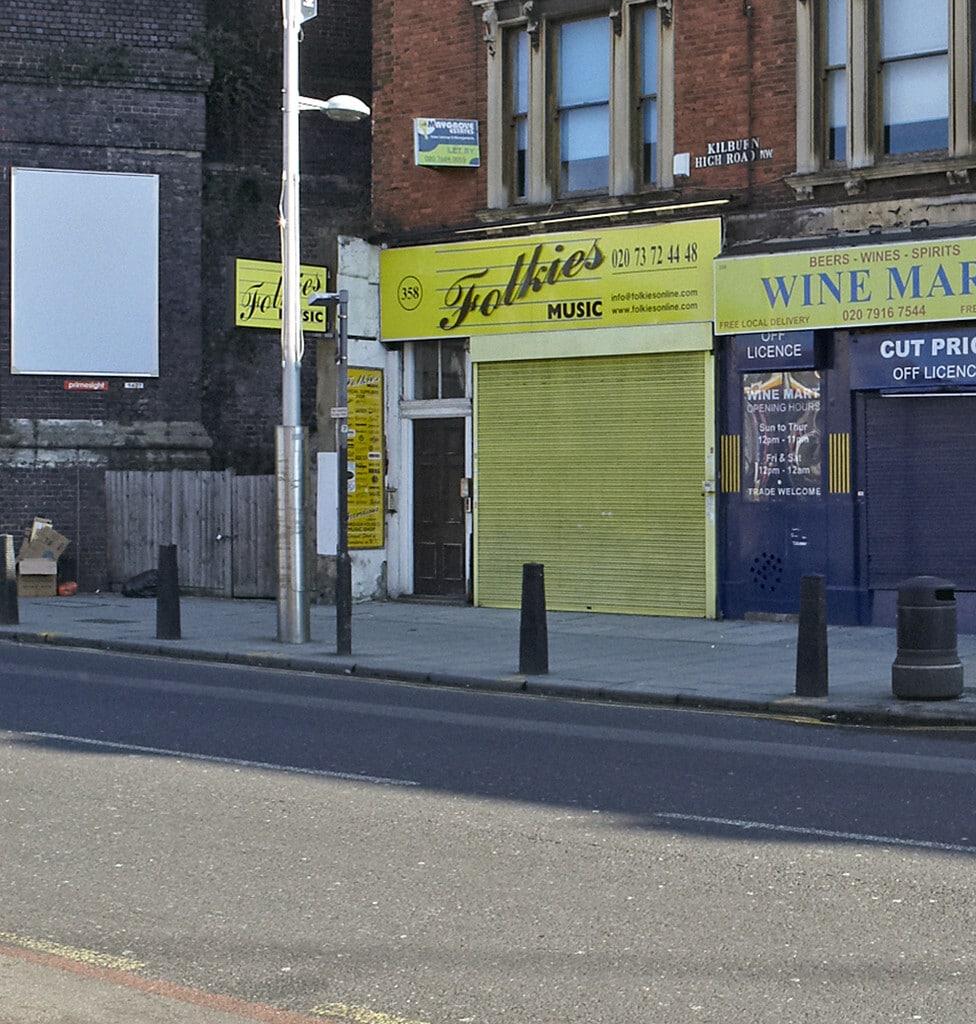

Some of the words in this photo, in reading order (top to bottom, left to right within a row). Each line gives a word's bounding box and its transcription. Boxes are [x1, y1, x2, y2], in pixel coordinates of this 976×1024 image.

[612, 248, 630, 268] 020
[634, 246, 646, 266] 73
[651, 245, 663, 265] 72
[667, 244, 680, 263] 44
[684, 242, 698, 262] 48
[810, 254, 850, 268] BEERS
[861, 249, 900, 263] WINES
[912, 244, 961, 259] SPIRITS
[439, 239, 605, 330] Folkies
[761, 269, 872, 309] WINE
[401, 287, 419, 300] 358
[611, 289, 698, 302] info@folkiesonline.com
[548, 301, 603, 319] MUSIC
[612, 302, 698, 314] www.folkiesonline.com
[842, 310, 863, 321] 020
[867, 307, 894, 319] 7916
[898, 305, 926, 317] 7544
[720, 321, 740, 329] FREE
[741, 319, 768, 328] LOCAL
[770, 316, 810, 326] DELIVERY
[747, 344, 802, 359] LICENCE
[880, 339, 925, 359] CUT
[893, 367, 920, 380] OFF
[747, 388, 780, 401] WINE
[747, 403, 787, 413] OPENING
[788, 400, 821, 412] HOURS
[759, 423, 776, 432] Sun
[777, 424, 787, 432] to
[788, 423, 808, 431] Thur
[759, 435, 780, 445] 12pm
[788, 435, 809, 444] 11pm
[766, 453, 777, 462] Fri
[779, 453, 785, 462] &
[788, 453, 802, 462] Sat
[759, 466, 780, 476] 12pm
[788, 466, 811, 474] 12am
[748, 488, 776, 496] TRADE
[778, 488, 821, 496] WELCOME
